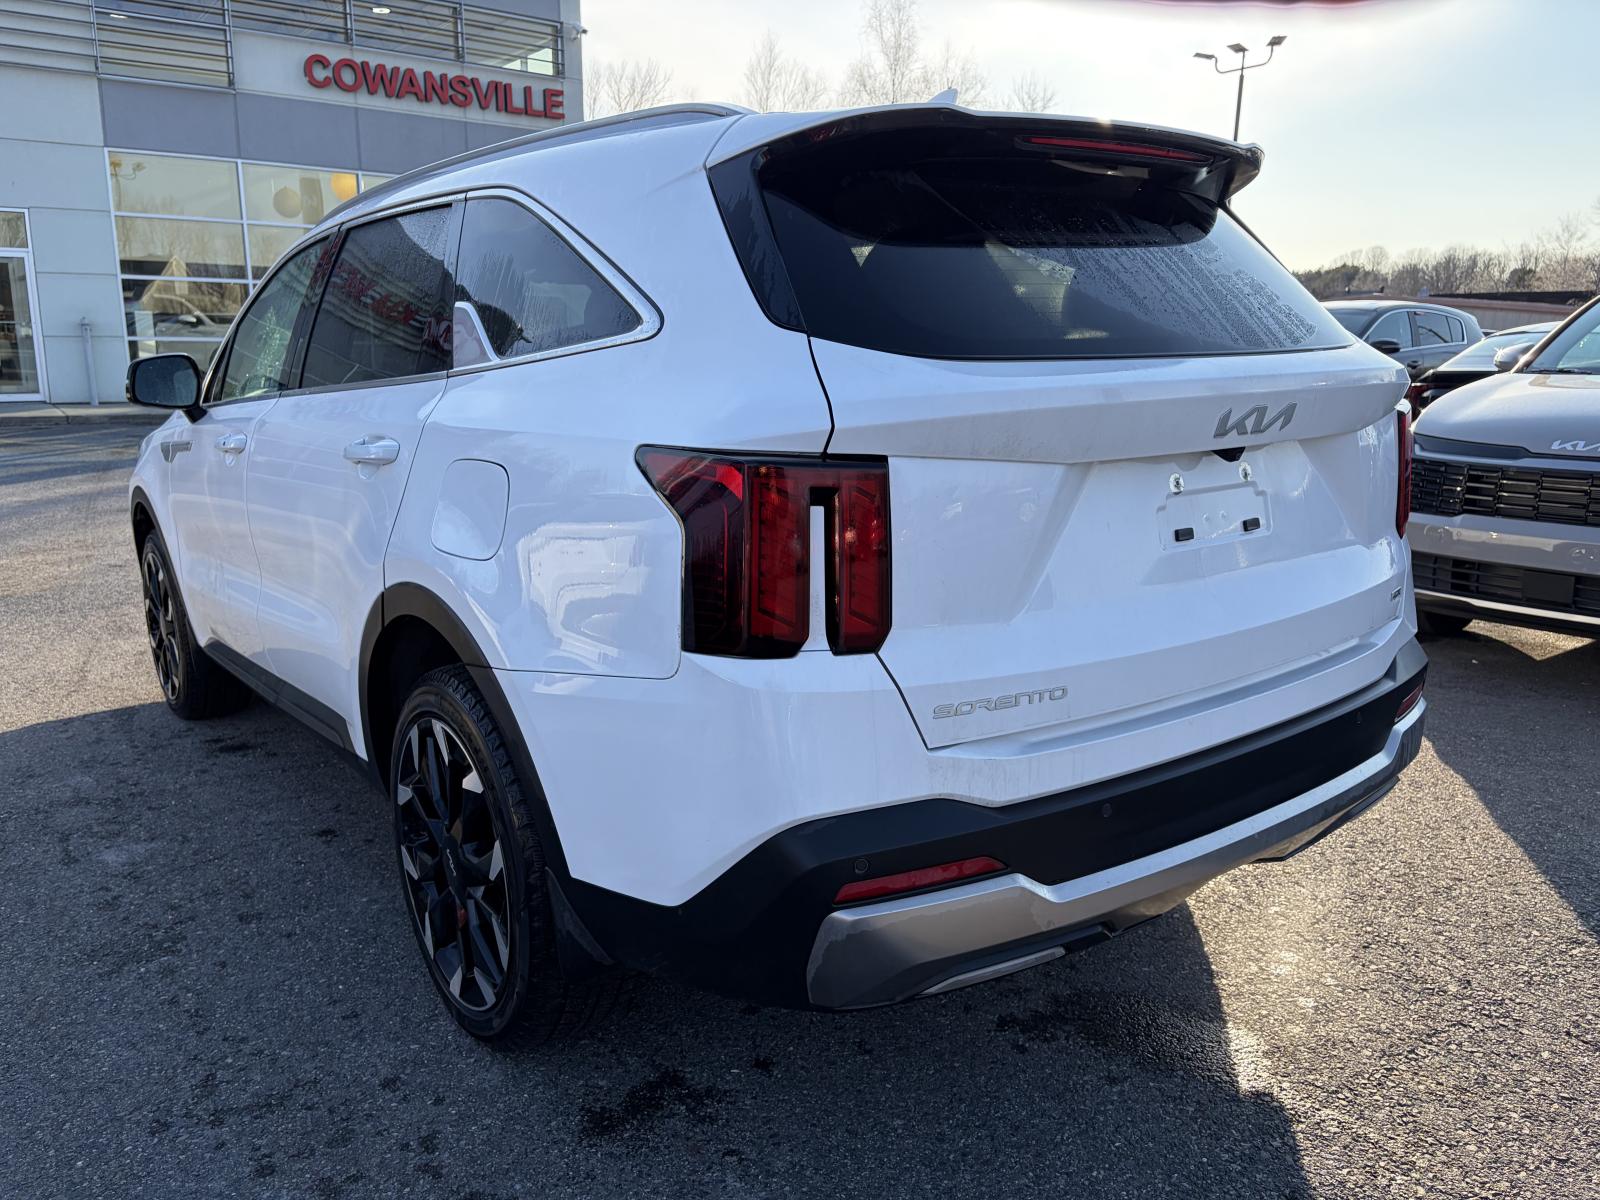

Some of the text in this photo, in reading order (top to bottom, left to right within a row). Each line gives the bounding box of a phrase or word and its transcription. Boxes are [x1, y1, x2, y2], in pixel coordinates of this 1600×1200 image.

[304, 54, 565, 119] COWANSVILLE
[1213, 402, 1298, 438] KIA
[932, 685, 1068, 719] SORENTO
